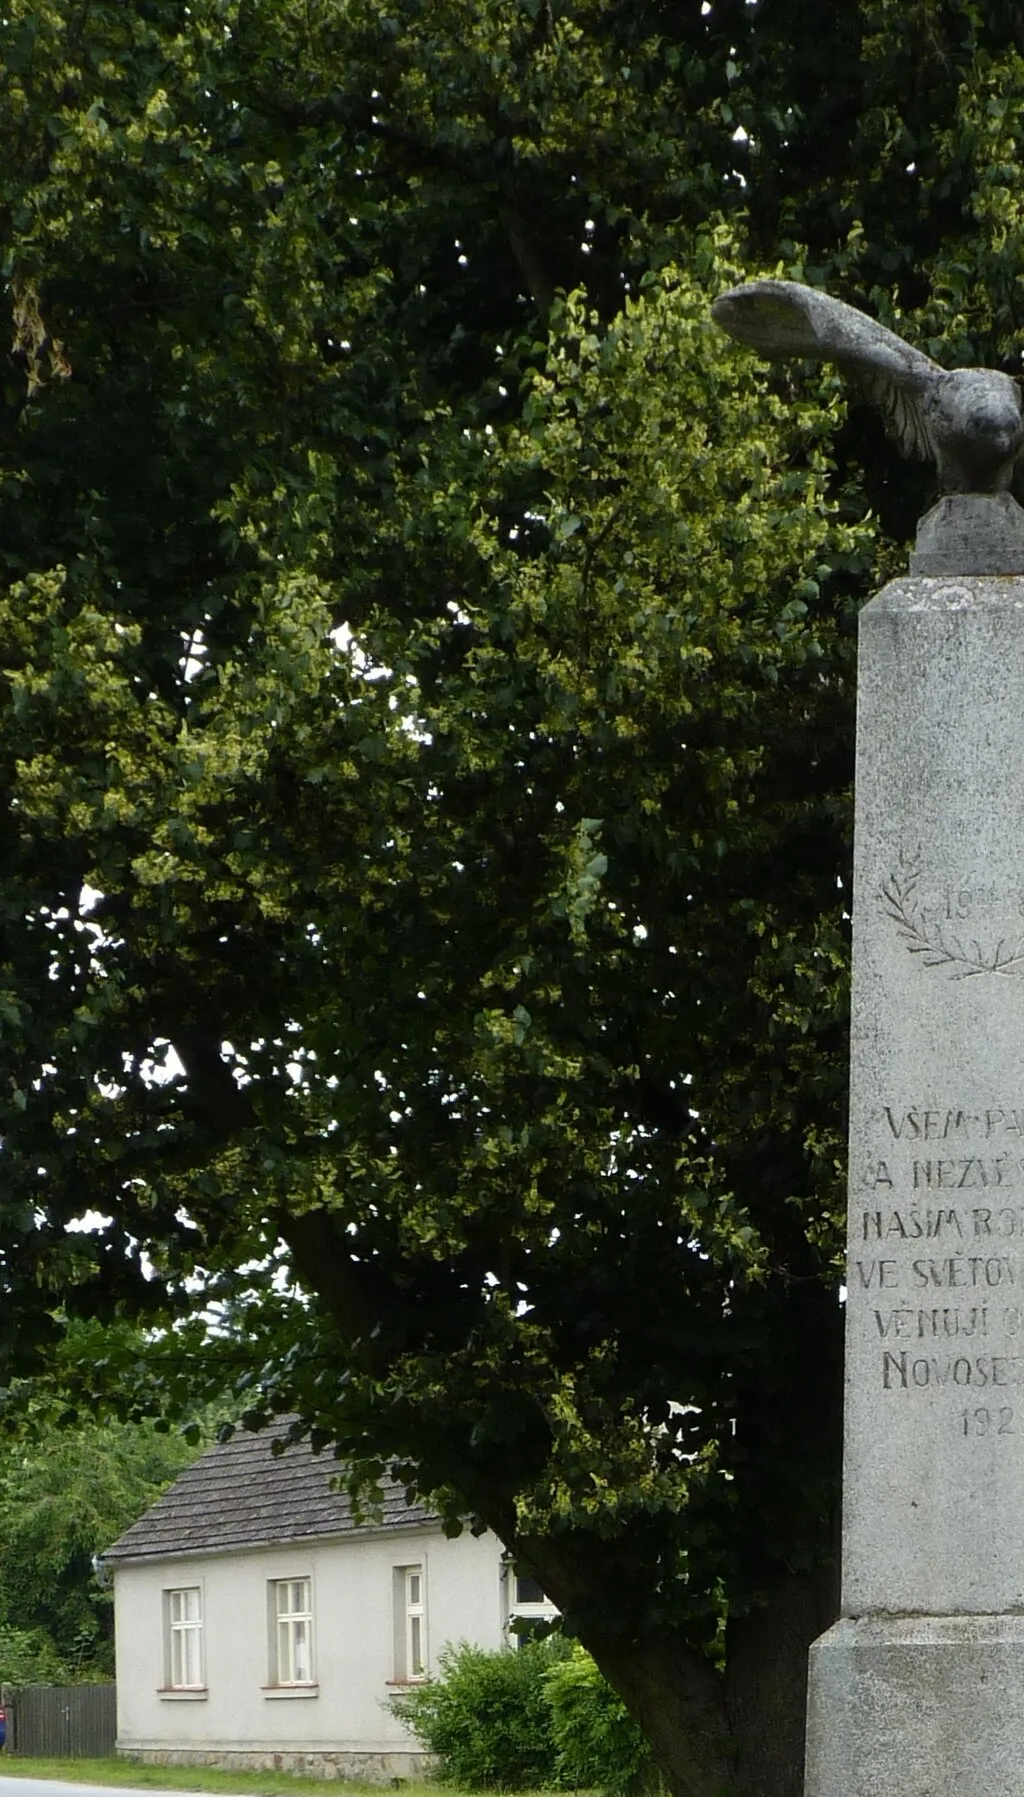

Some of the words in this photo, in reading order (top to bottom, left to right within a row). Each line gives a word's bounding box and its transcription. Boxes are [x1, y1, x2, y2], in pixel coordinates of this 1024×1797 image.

[884, 1105, 968, 1141] VŠEM
[874, 1160, 893, 1190] A
[855, 1259, 899, 1289] VE
